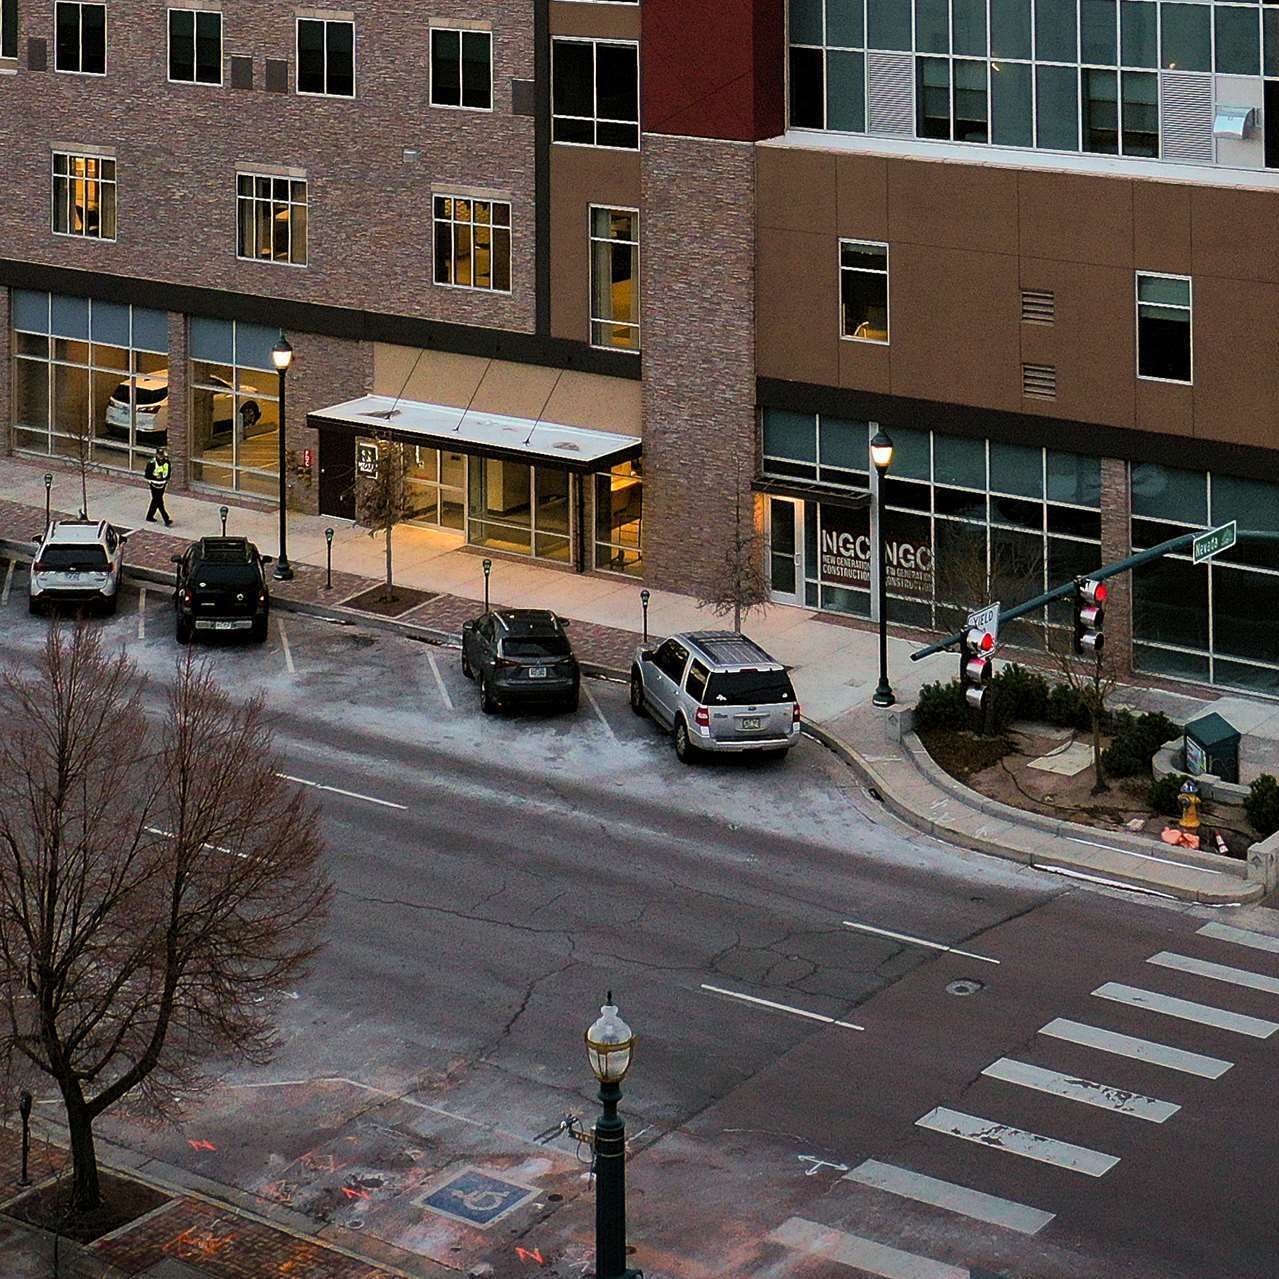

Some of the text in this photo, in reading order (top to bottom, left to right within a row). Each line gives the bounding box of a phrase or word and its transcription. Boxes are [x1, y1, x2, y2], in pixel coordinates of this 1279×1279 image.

[822, 529, 871, 560] NGC
[1195, 537, 1218, 558] Nevada
[822, 554, 836, 565] NEW
[886, 566, 896, 577] EW
[973, 610, 993, 625] YIELD
